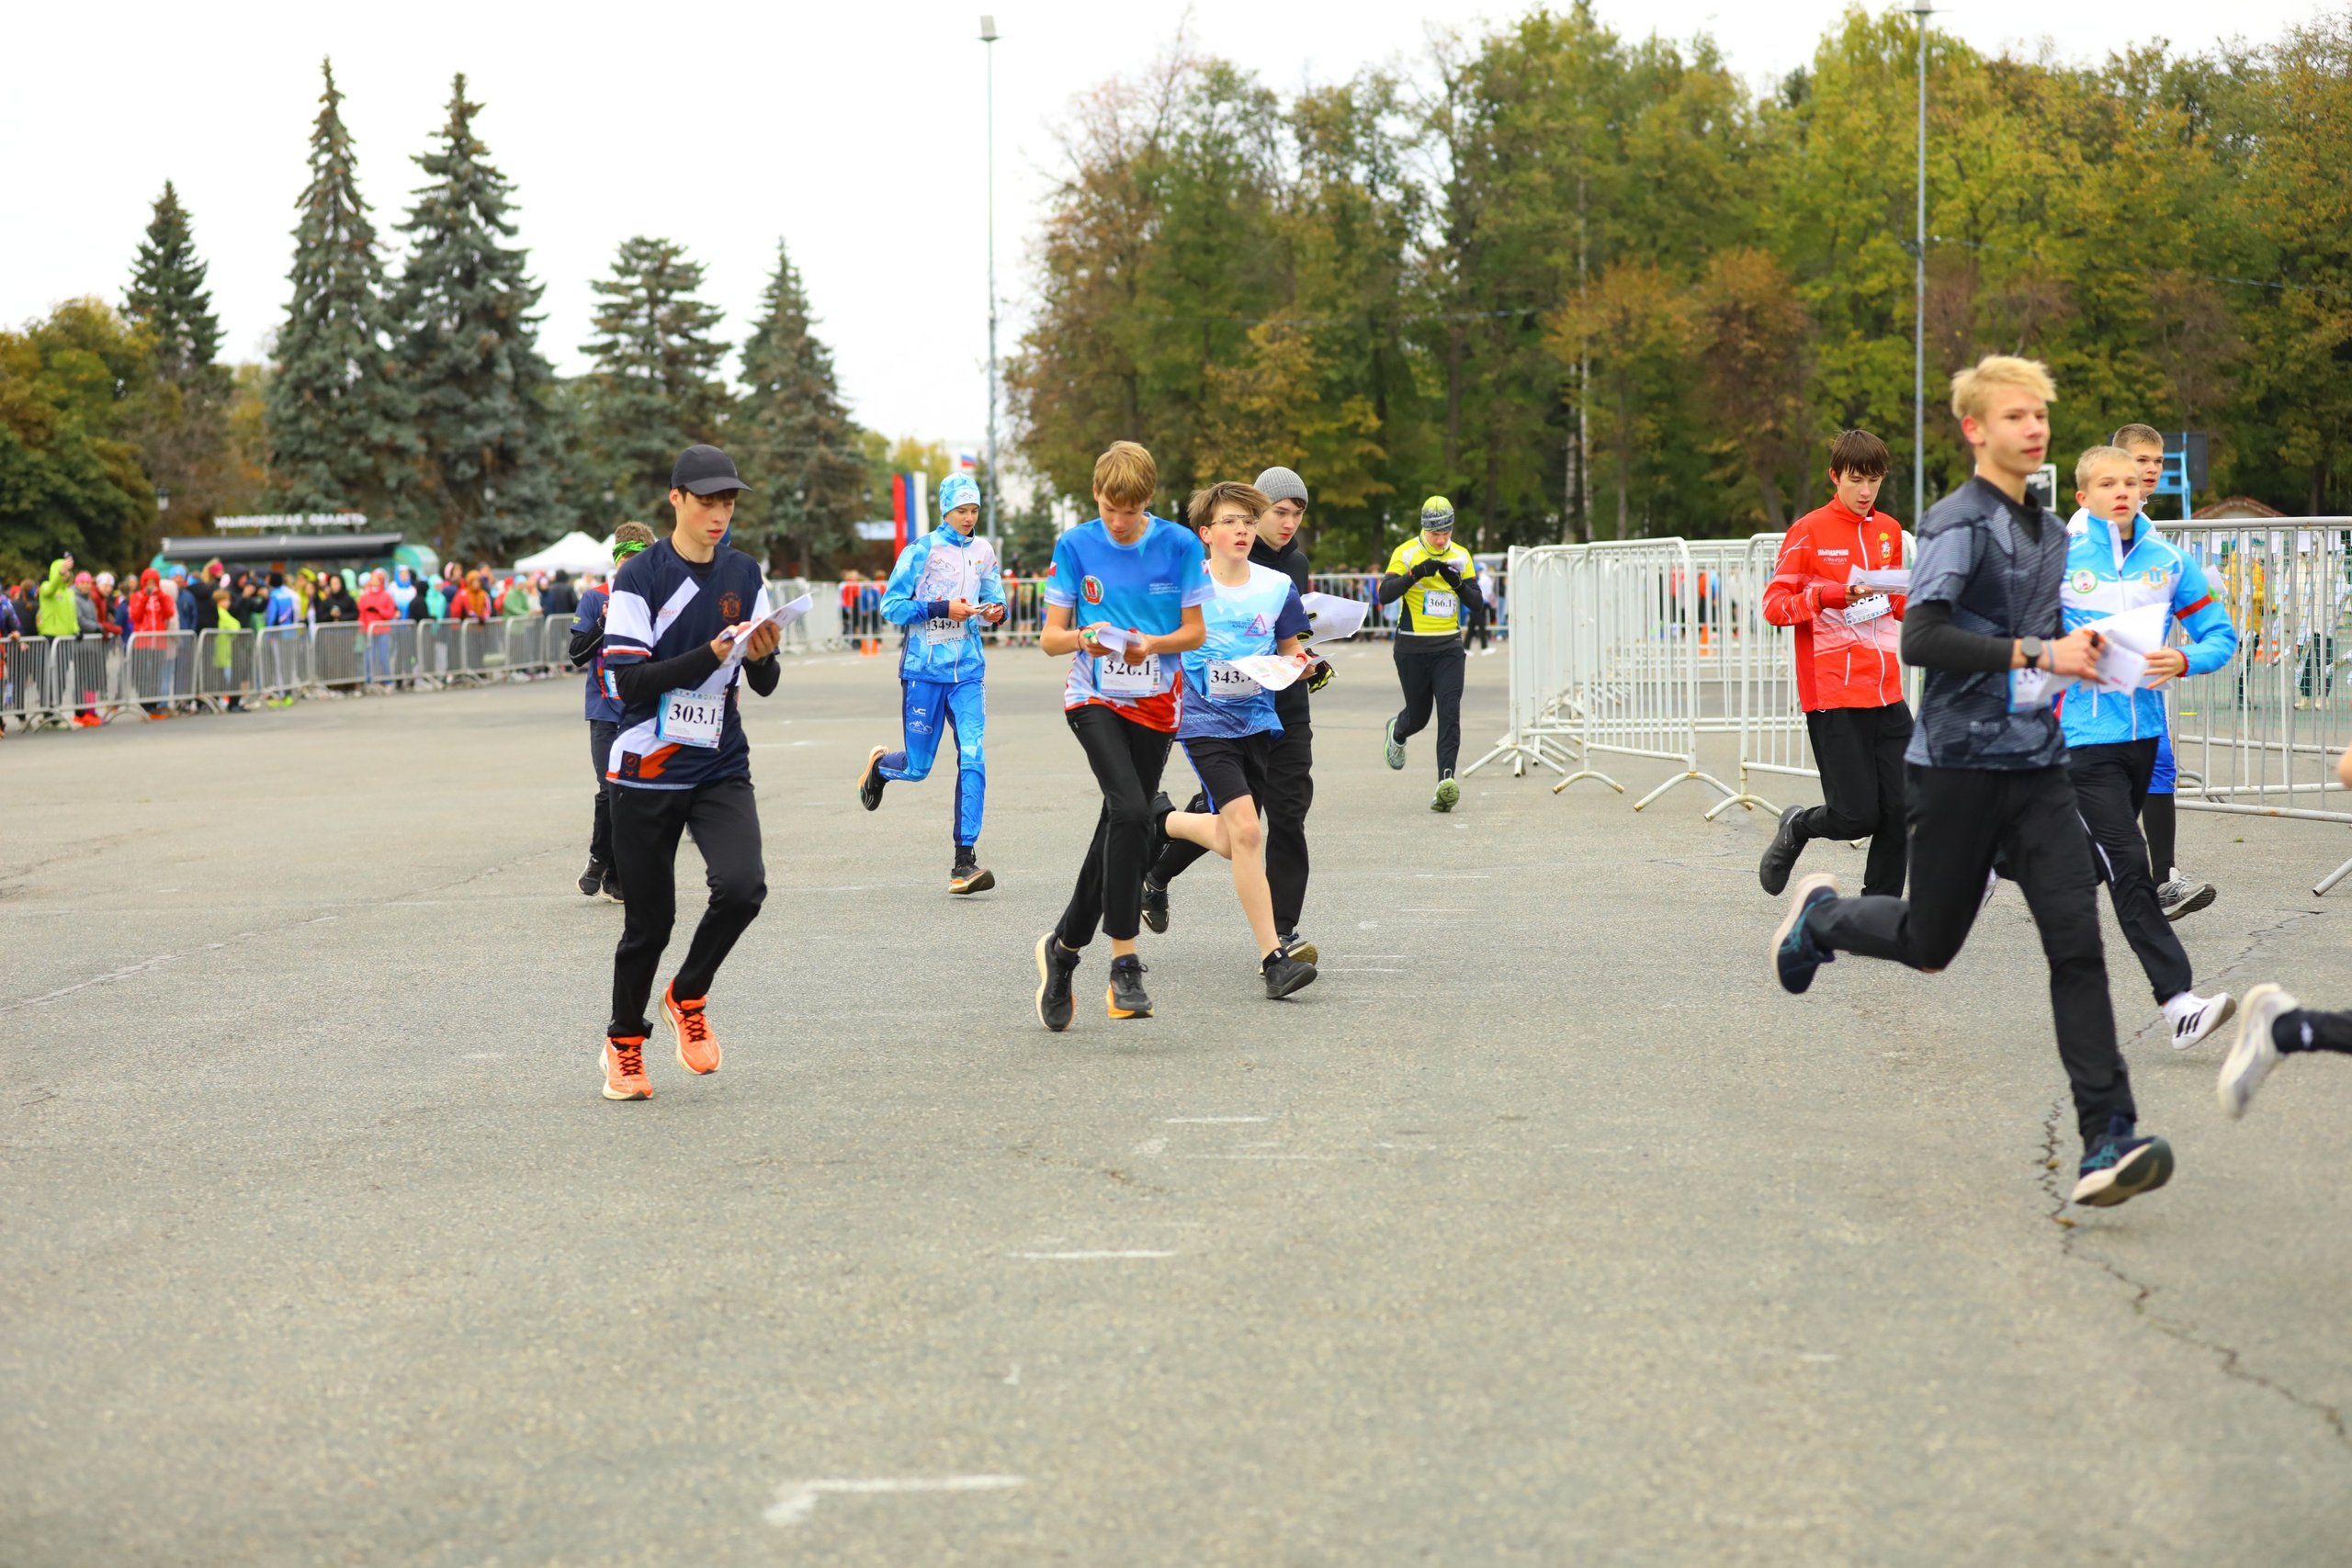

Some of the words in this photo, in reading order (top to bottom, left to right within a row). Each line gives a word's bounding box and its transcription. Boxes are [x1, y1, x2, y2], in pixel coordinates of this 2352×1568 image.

[308, 513, 368, 526] ОБЛАСТЬ
[1429, 598, 1452, 607] 366.1
[931, 619, 961, 632] 349.1
[669, 703, 717, 726] 303.1
